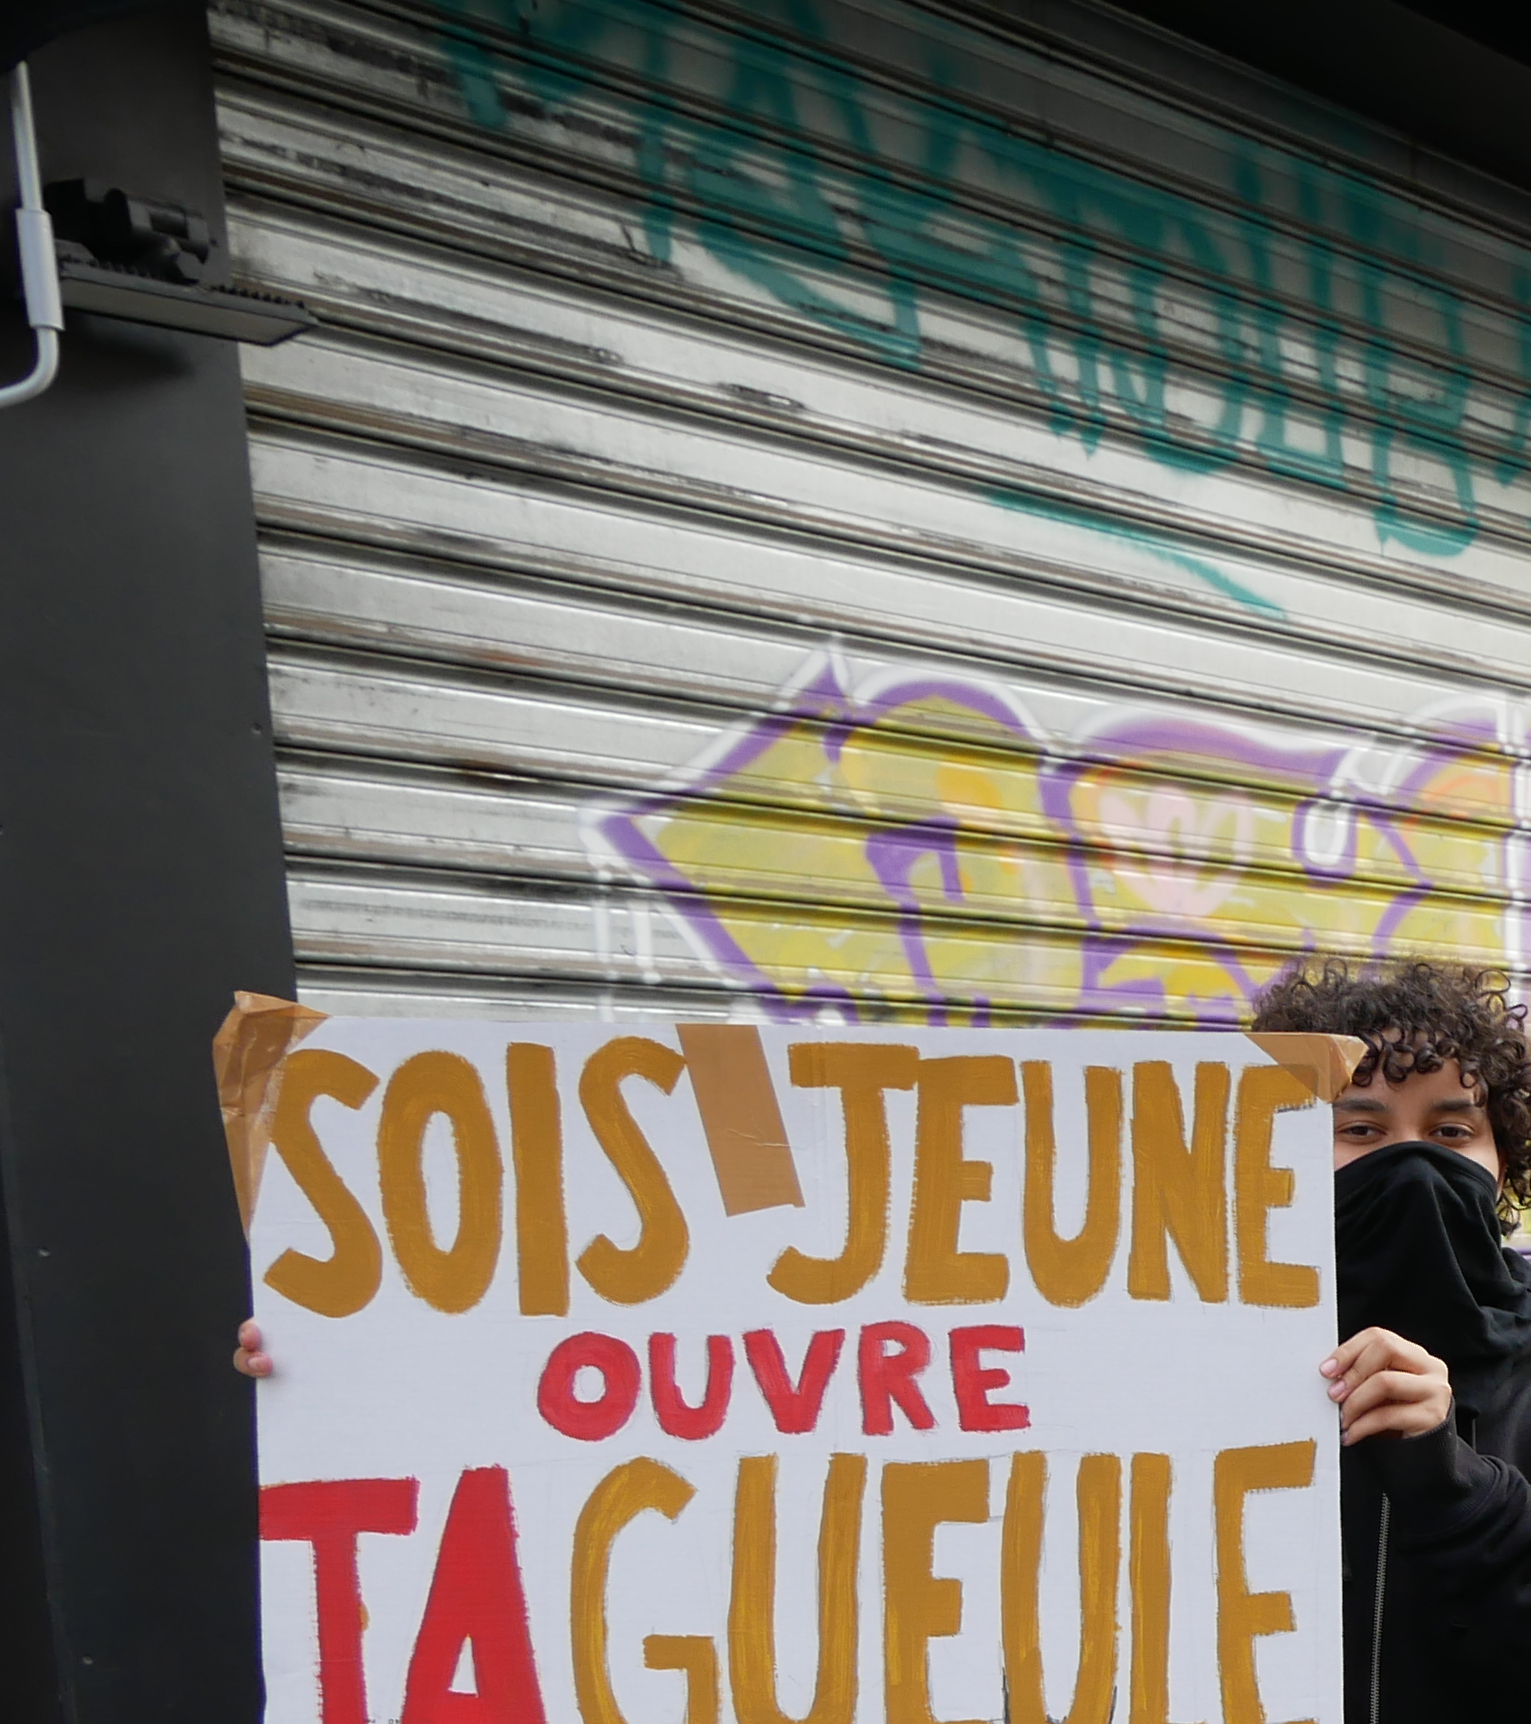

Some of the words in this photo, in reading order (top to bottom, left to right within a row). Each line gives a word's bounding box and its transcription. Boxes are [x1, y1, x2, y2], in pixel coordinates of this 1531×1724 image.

[263, 1037, 689, 1317] SOIS
[767, 1041, 1322, 1308] JEUNE
[536, 1322, 1031, 1441] OUVRE
